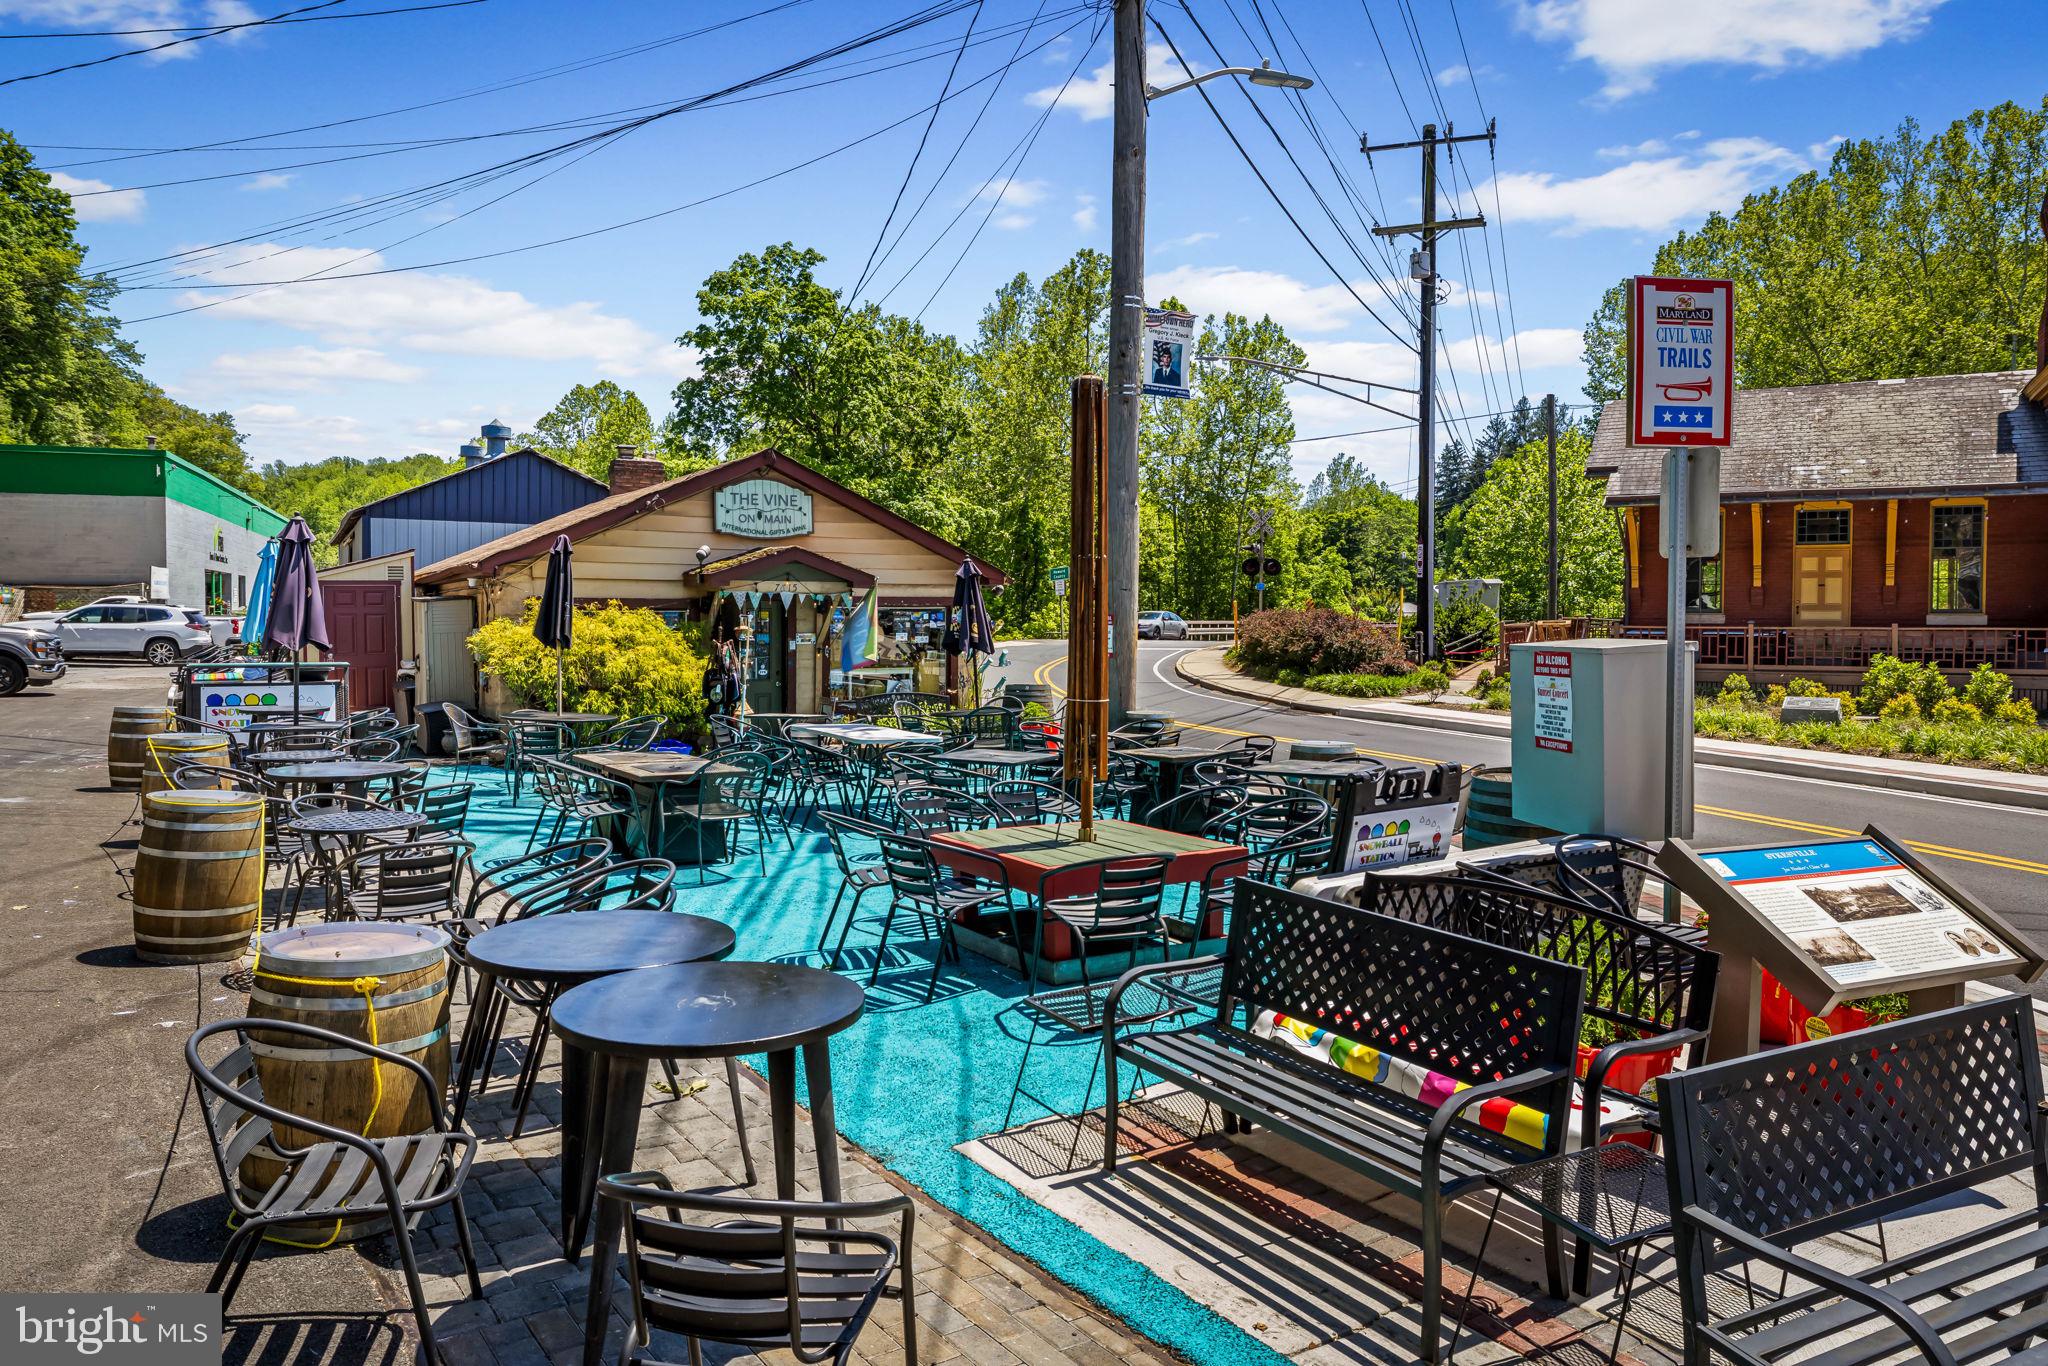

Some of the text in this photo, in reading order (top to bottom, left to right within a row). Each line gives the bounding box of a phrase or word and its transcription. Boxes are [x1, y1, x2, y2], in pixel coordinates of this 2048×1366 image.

[1660, 307, 1711, 320] MARYLAND
[1656, 327, 1713, 344] CIVIL WAR
[1658, 347, 1712, 368] TRAILS
[730, 492, 798, 507] THE VINE
[738, 514, 792, 524] ON MAIN
[722, 522, 768, 535] INTERNATIONAL
[792, 524, 807, 533] WINE
[1536, 655, 1568, 665] NO ALCOHOL
[1359, 838, 1404, 852] SNOWBALL
[1360, 852, 1396, 864] STATION
[1764, 849, 1818, 860] SYKESVILLE
